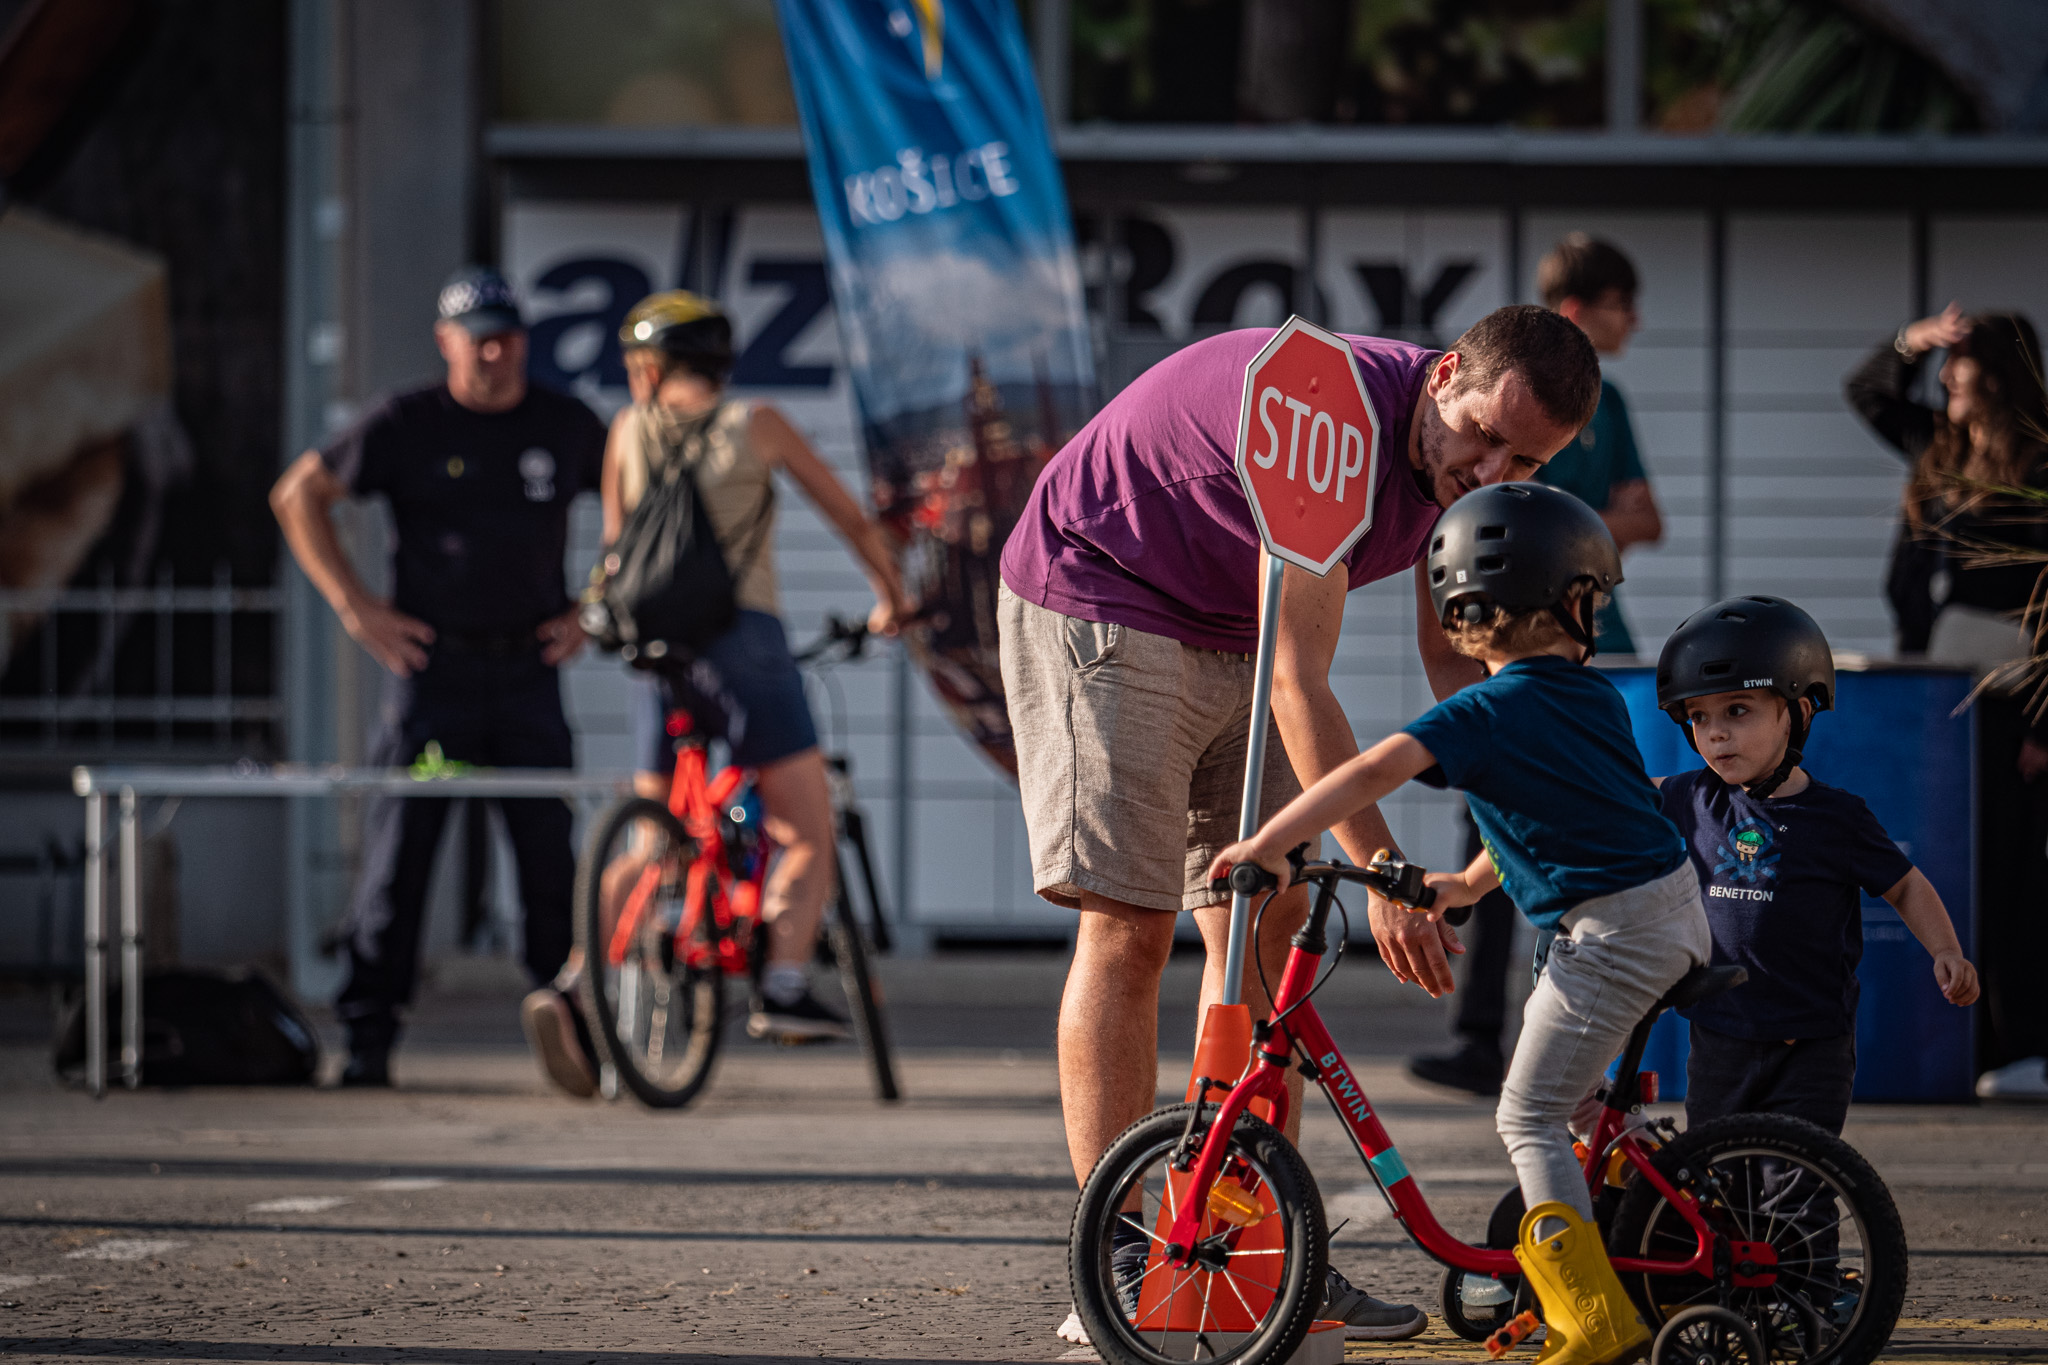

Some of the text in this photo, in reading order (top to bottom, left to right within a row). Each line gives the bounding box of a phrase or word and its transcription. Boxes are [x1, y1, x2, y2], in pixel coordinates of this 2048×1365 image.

[844, 141, 1020, 228] KOŠICE
[1253, 386, 1364, 503] STOP
[1743, 678, 1773, 688] BTWIN
[1709, 885, 1774, 902] BENETTON
